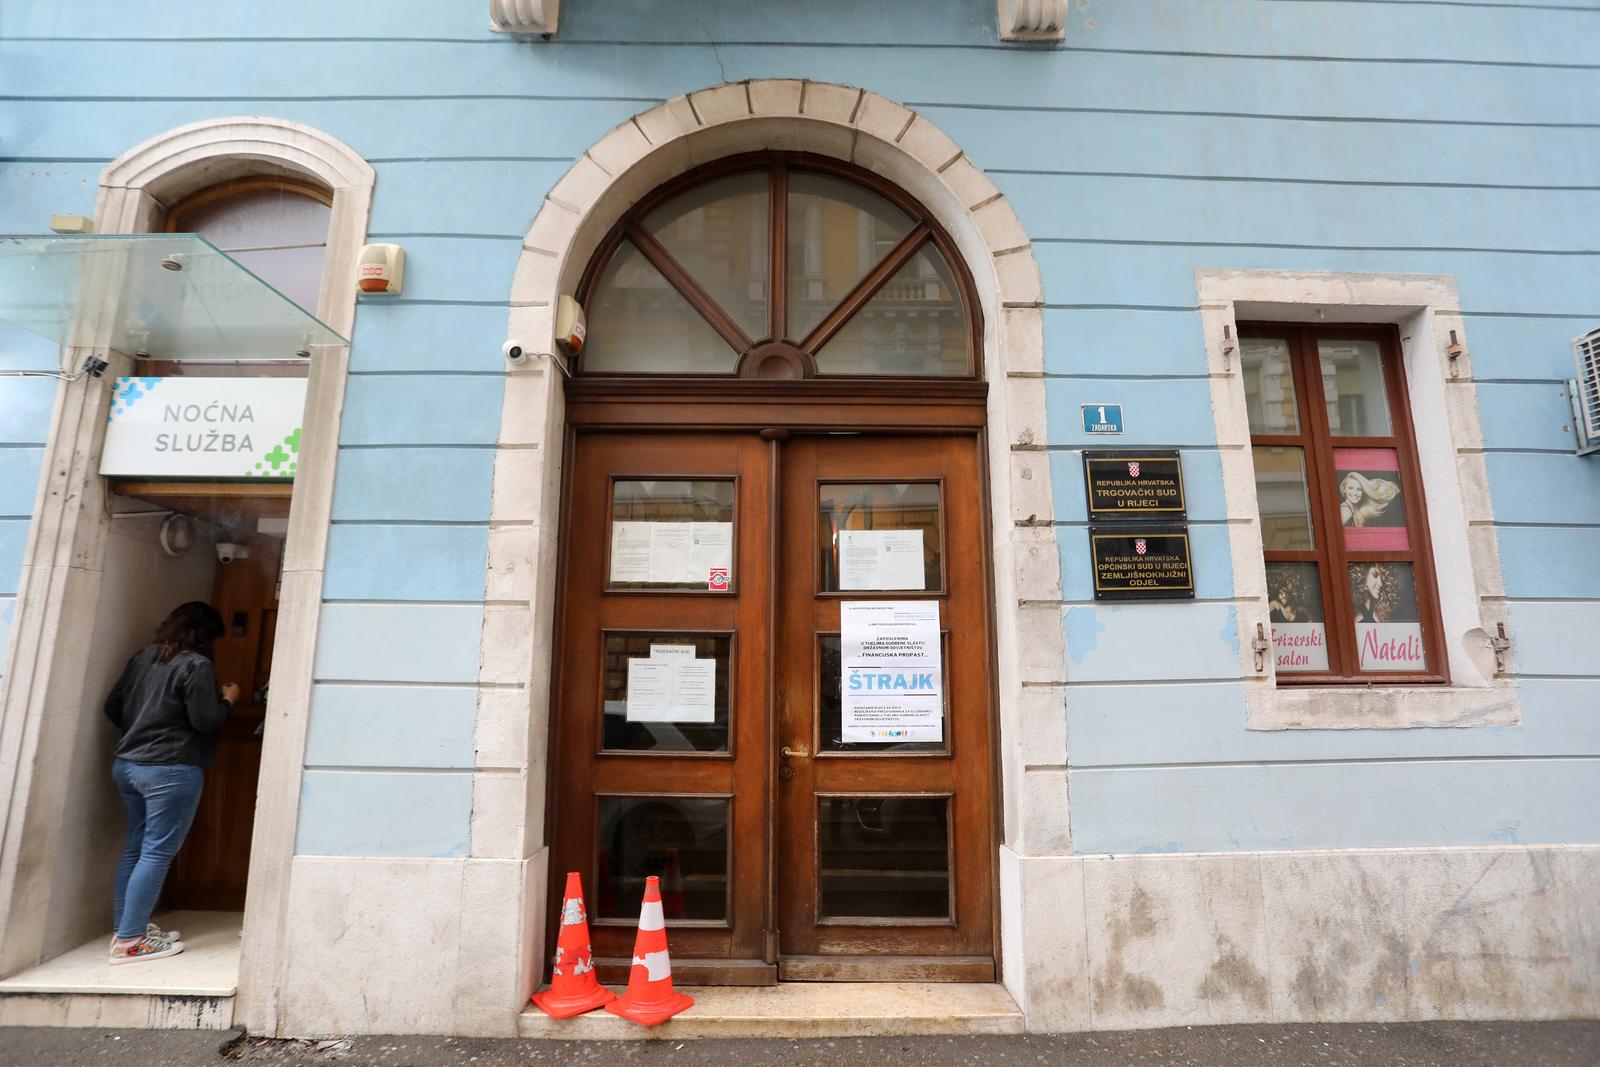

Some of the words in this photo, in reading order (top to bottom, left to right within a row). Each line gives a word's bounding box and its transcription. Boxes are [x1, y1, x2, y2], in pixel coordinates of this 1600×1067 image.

[164, 399, 254, 422] NOĆNA
[1097, 406, 1107, 424] 1
[1091, 423, 1118, 432] ZADARSKA
[154, 429, 253, 452] SLUŽBA
[1096, 488, 1154, 497] TRGOVAČKI
[1117, 499, 1125, 507] U
[1127, 499, 1159, 507] RIJECI
[1101, 570, 1187, 579] ZEMLJIŠNOKNJIŽNI
[1360, 628, 1421, 667] Natali
[1277, 650, 1309, 666] salon
[848, 669, 934, 690] ŠTRAJK
